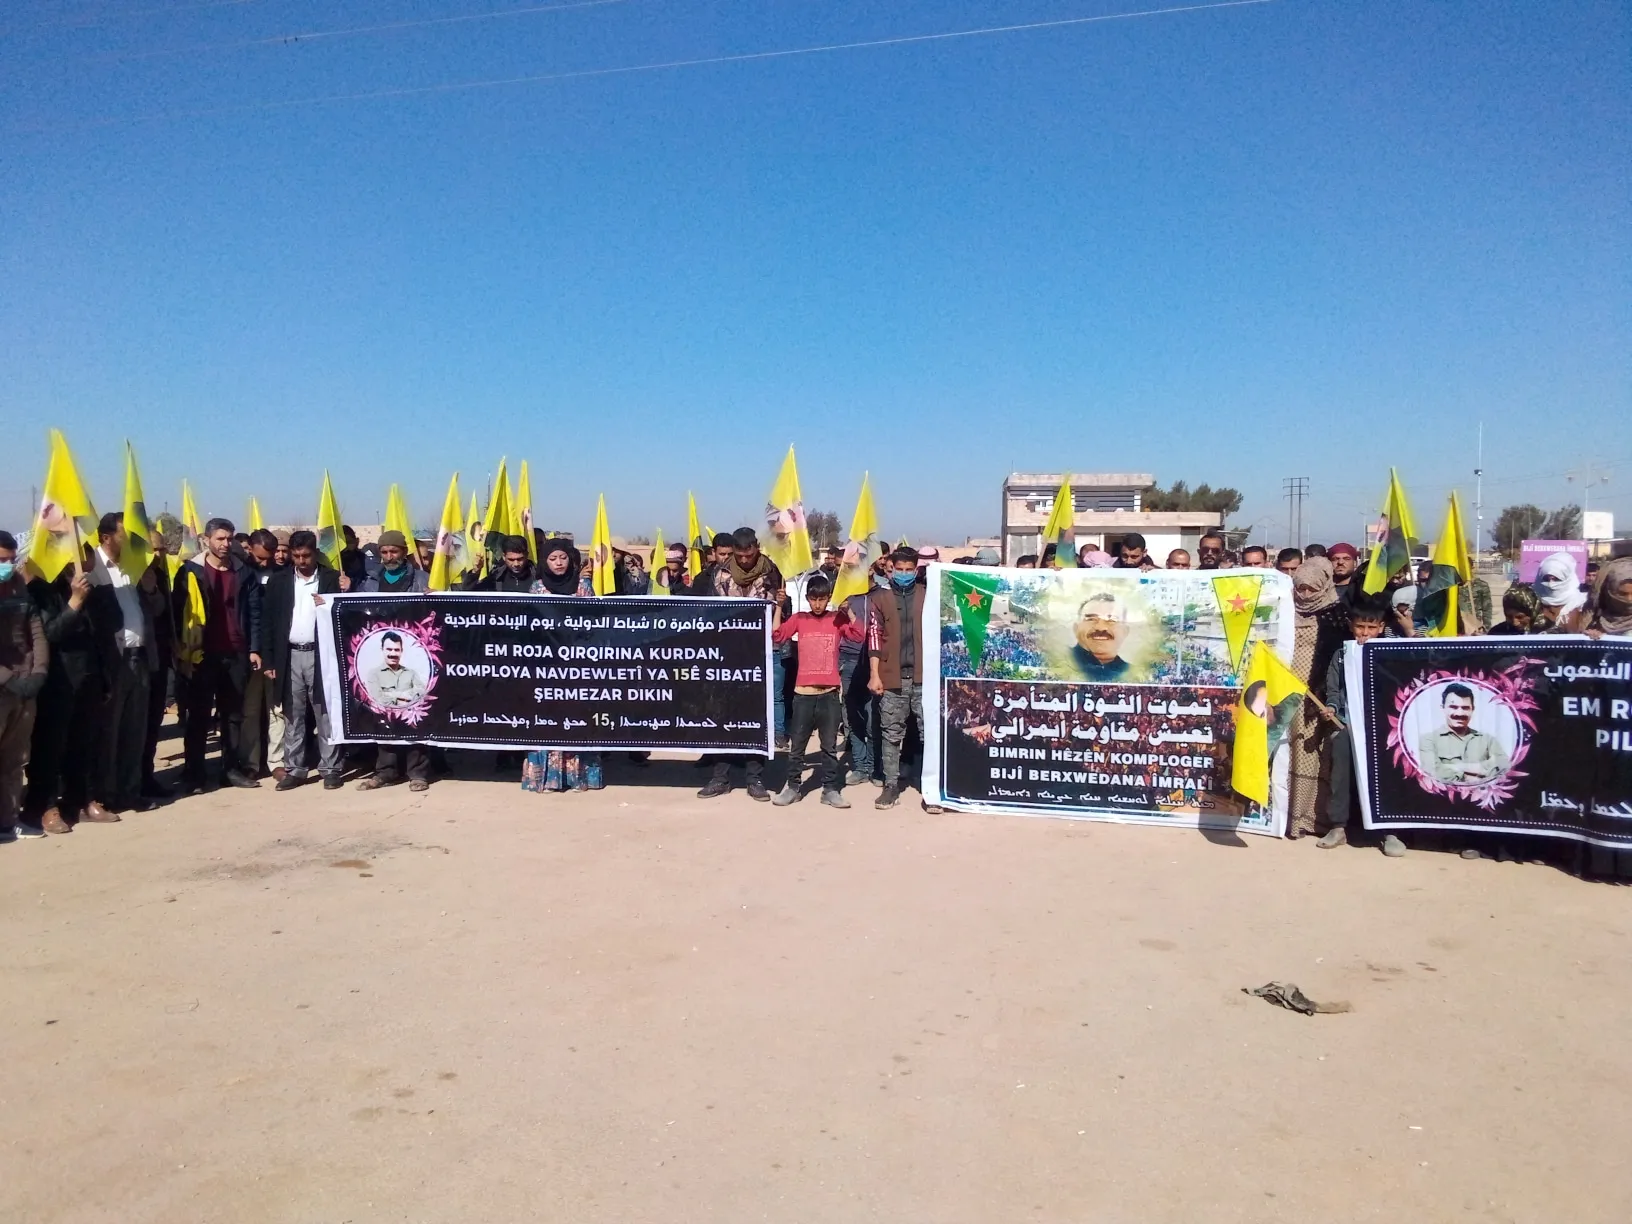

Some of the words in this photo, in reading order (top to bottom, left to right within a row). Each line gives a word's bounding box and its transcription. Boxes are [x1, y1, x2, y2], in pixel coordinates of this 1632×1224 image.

[444, 613, 486, 628] الكردية
[489, 614, 527, 631] الإبادة
[530, 618, 554, 631] يوم
[564, 616, 610, 631] الدولية
[613, 616, 650, 632] شباط
[670, 618, 714, 633] مؤامرة
[718, 618, 762, 633] نستنكر
[485, 644, 508, 657] EM
[513, 645, 553, 658] ROJA
[558, 646, 644, 661] QIRQIRINA
[650, 648, 724, 662] KURDAN,
[446, 664, 531, 679] KOMPLOYA
[536, 665, 642, 680] NAVDEWLETÎ
[647, 669, 669, 680] YA
[673, 665, 700, 681] 15Ê
[706, 666, 762, 682] SIBATÊ
[1544, 659, 1630, 682] الشعوب
[534, 688, 622, 703] ŞERMEZAR
[628, 689, 673, 701] DIKIN
[993, 686, 1078, 712] المتأمرة
[1148, 698, 1212, 719] تموت
[1562, 696, 1600, 717] EM
[1611, 699, 1632, 720] R
[1071, 720, 1140, 744] مقاومة
[1148, 722, 1213, 747] تعيش
[988, 746, 1046, 760] BIMRIN
[1051, 747, 1105, 763] HÊZÊN
[1110, 753, 1215, 768] KOMPLOGER
[990, 765, 1022, 780] BIJÎ
[1029, 770, 1146, 786] BERXWEDANA
[1152, 773, 1213, 790] ÎMRALÎ
